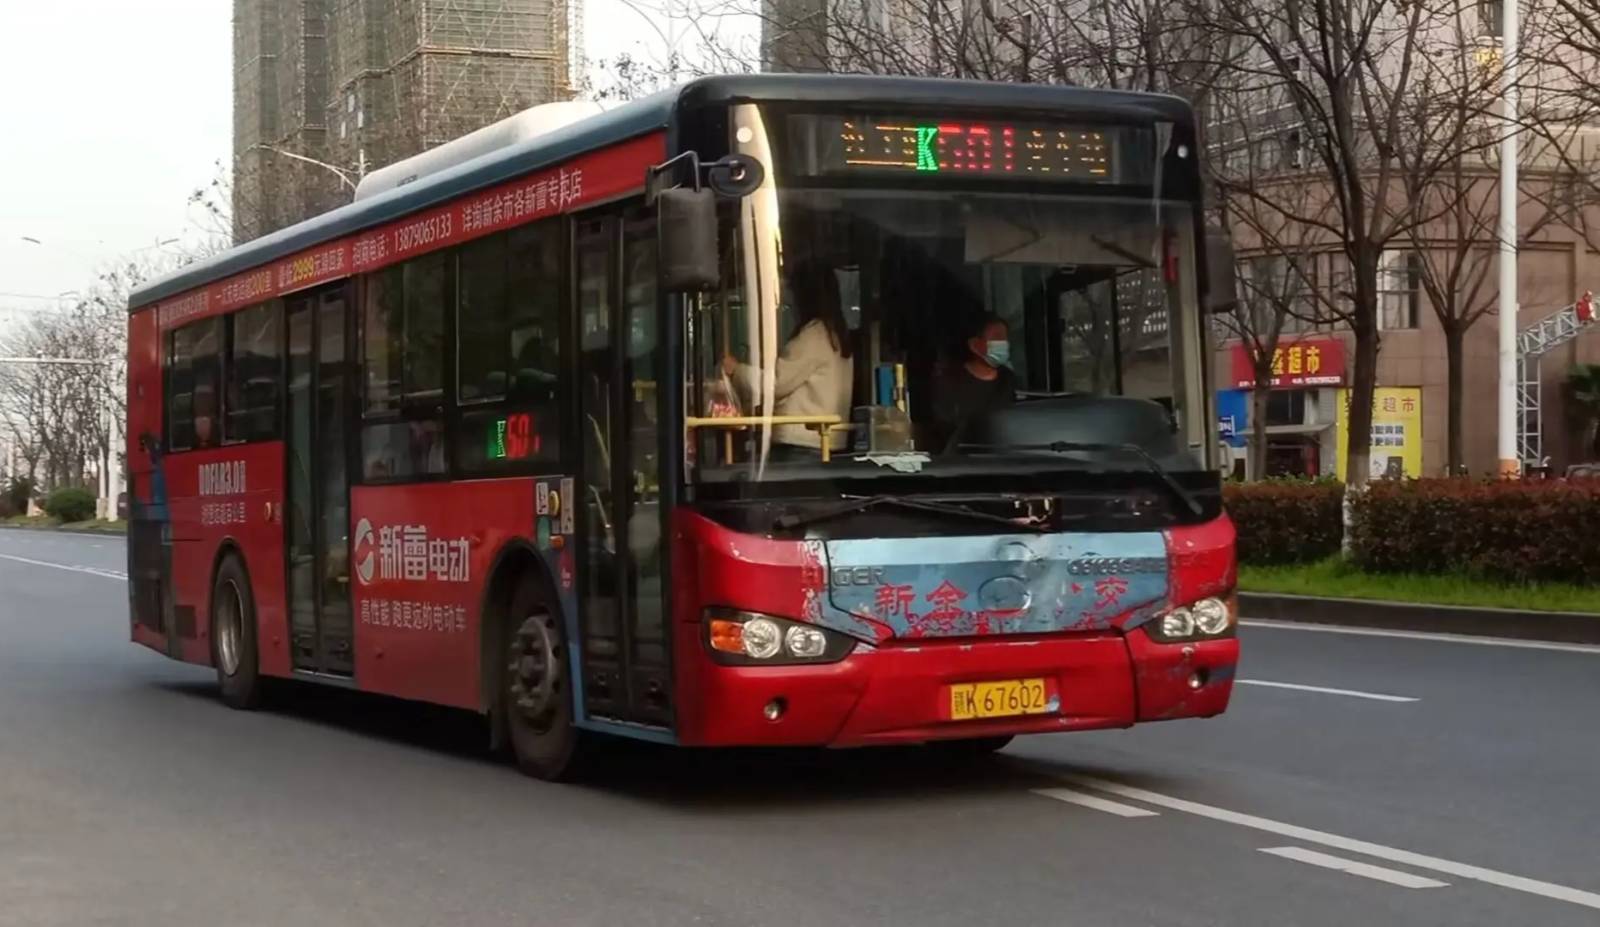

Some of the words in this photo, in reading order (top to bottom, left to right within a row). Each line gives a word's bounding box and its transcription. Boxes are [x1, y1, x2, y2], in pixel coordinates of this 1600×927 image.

[394, 212, 452, 253] 13879065133
[379, 525, 470, 582] 新蕾电动
